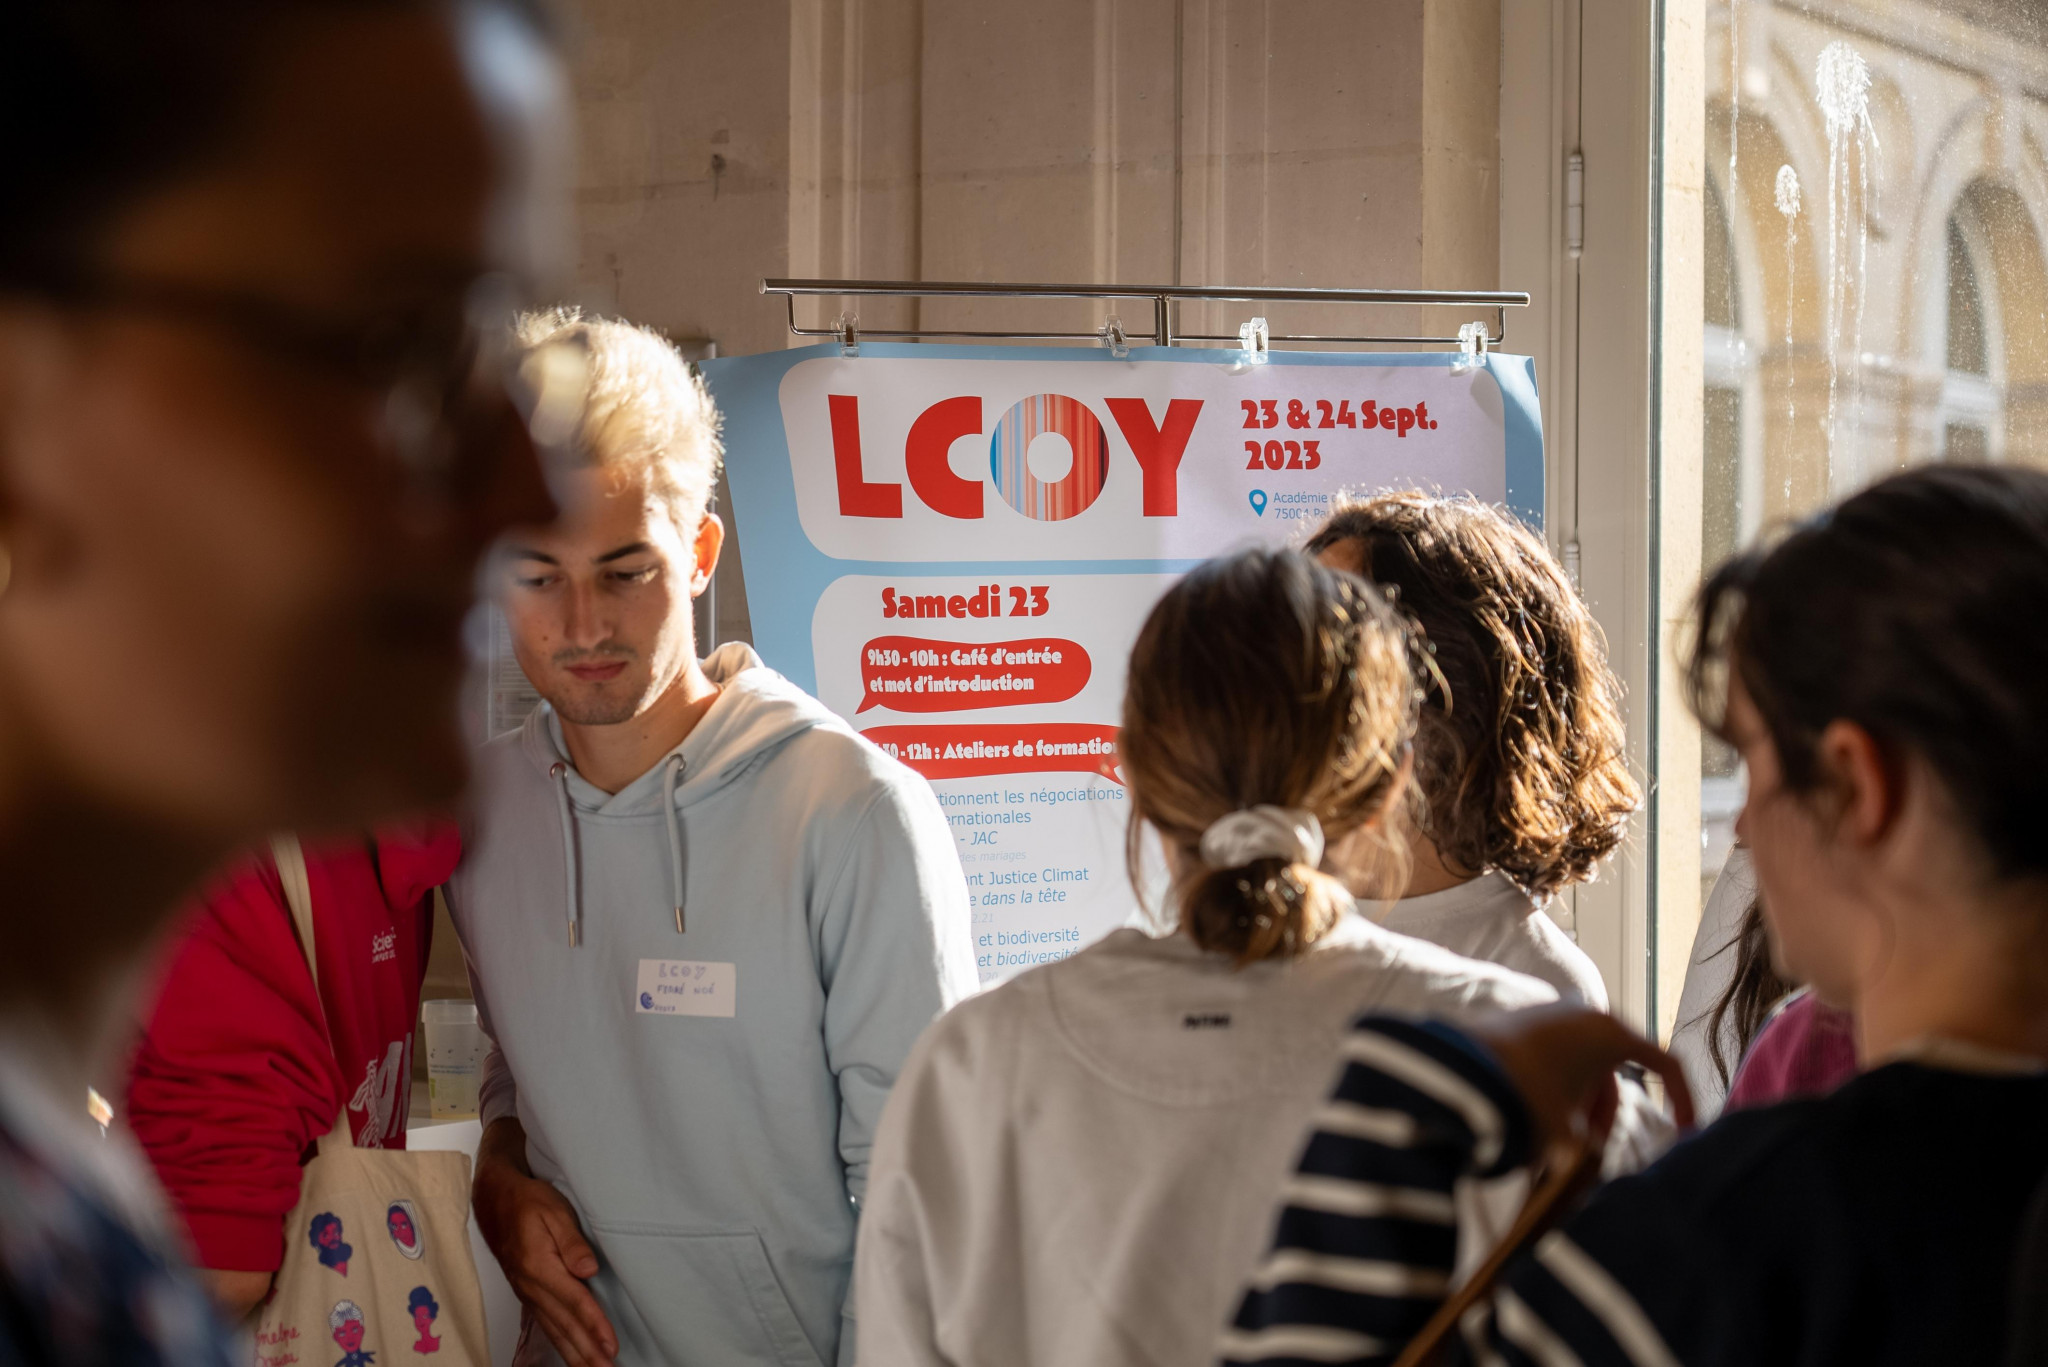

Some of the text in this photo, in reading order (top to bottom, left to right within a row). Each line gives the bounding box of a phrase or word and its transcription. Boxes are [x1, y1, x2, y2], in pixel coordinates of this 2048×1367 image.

[1241, 399, 1438, 438] 23 & 24 Sept.
[828, 393, 1204, 521] LCOY
[1244, 440, 1321, 470] 2023
[1273, 491, 1328, 503] Académie
[881, 584, 1050, 618] Samedi 23
[867, 648, 900, 666] 9h30
[910, 650, 939, 666] 10h
[951, 648, 988, 666] Café
[991, 646, 1062, 665] d'entrée
[870, 673, 1034, 693] et mot d'introduction
[907, 743, 932, 760] 12h
[943, 740, 1008, 759] Ateliers
[1012, 740, 1034, 757] de
[1004, 789, 1024, 803] les
[1030, 787, 1123, 805] négociations
[970, 830, 998, 846] JAC
[989, 871, 1037, 885] Justice
[1042, 868, 1089, 882] Climat
[982, 891, 1016, 906] dans
[1020, 890, 1033, 904] la
[1038, 887, 1067, 903] tête
[978, 926, 1080, 946] et biodiversité
[977, 953, 993, 967] et
